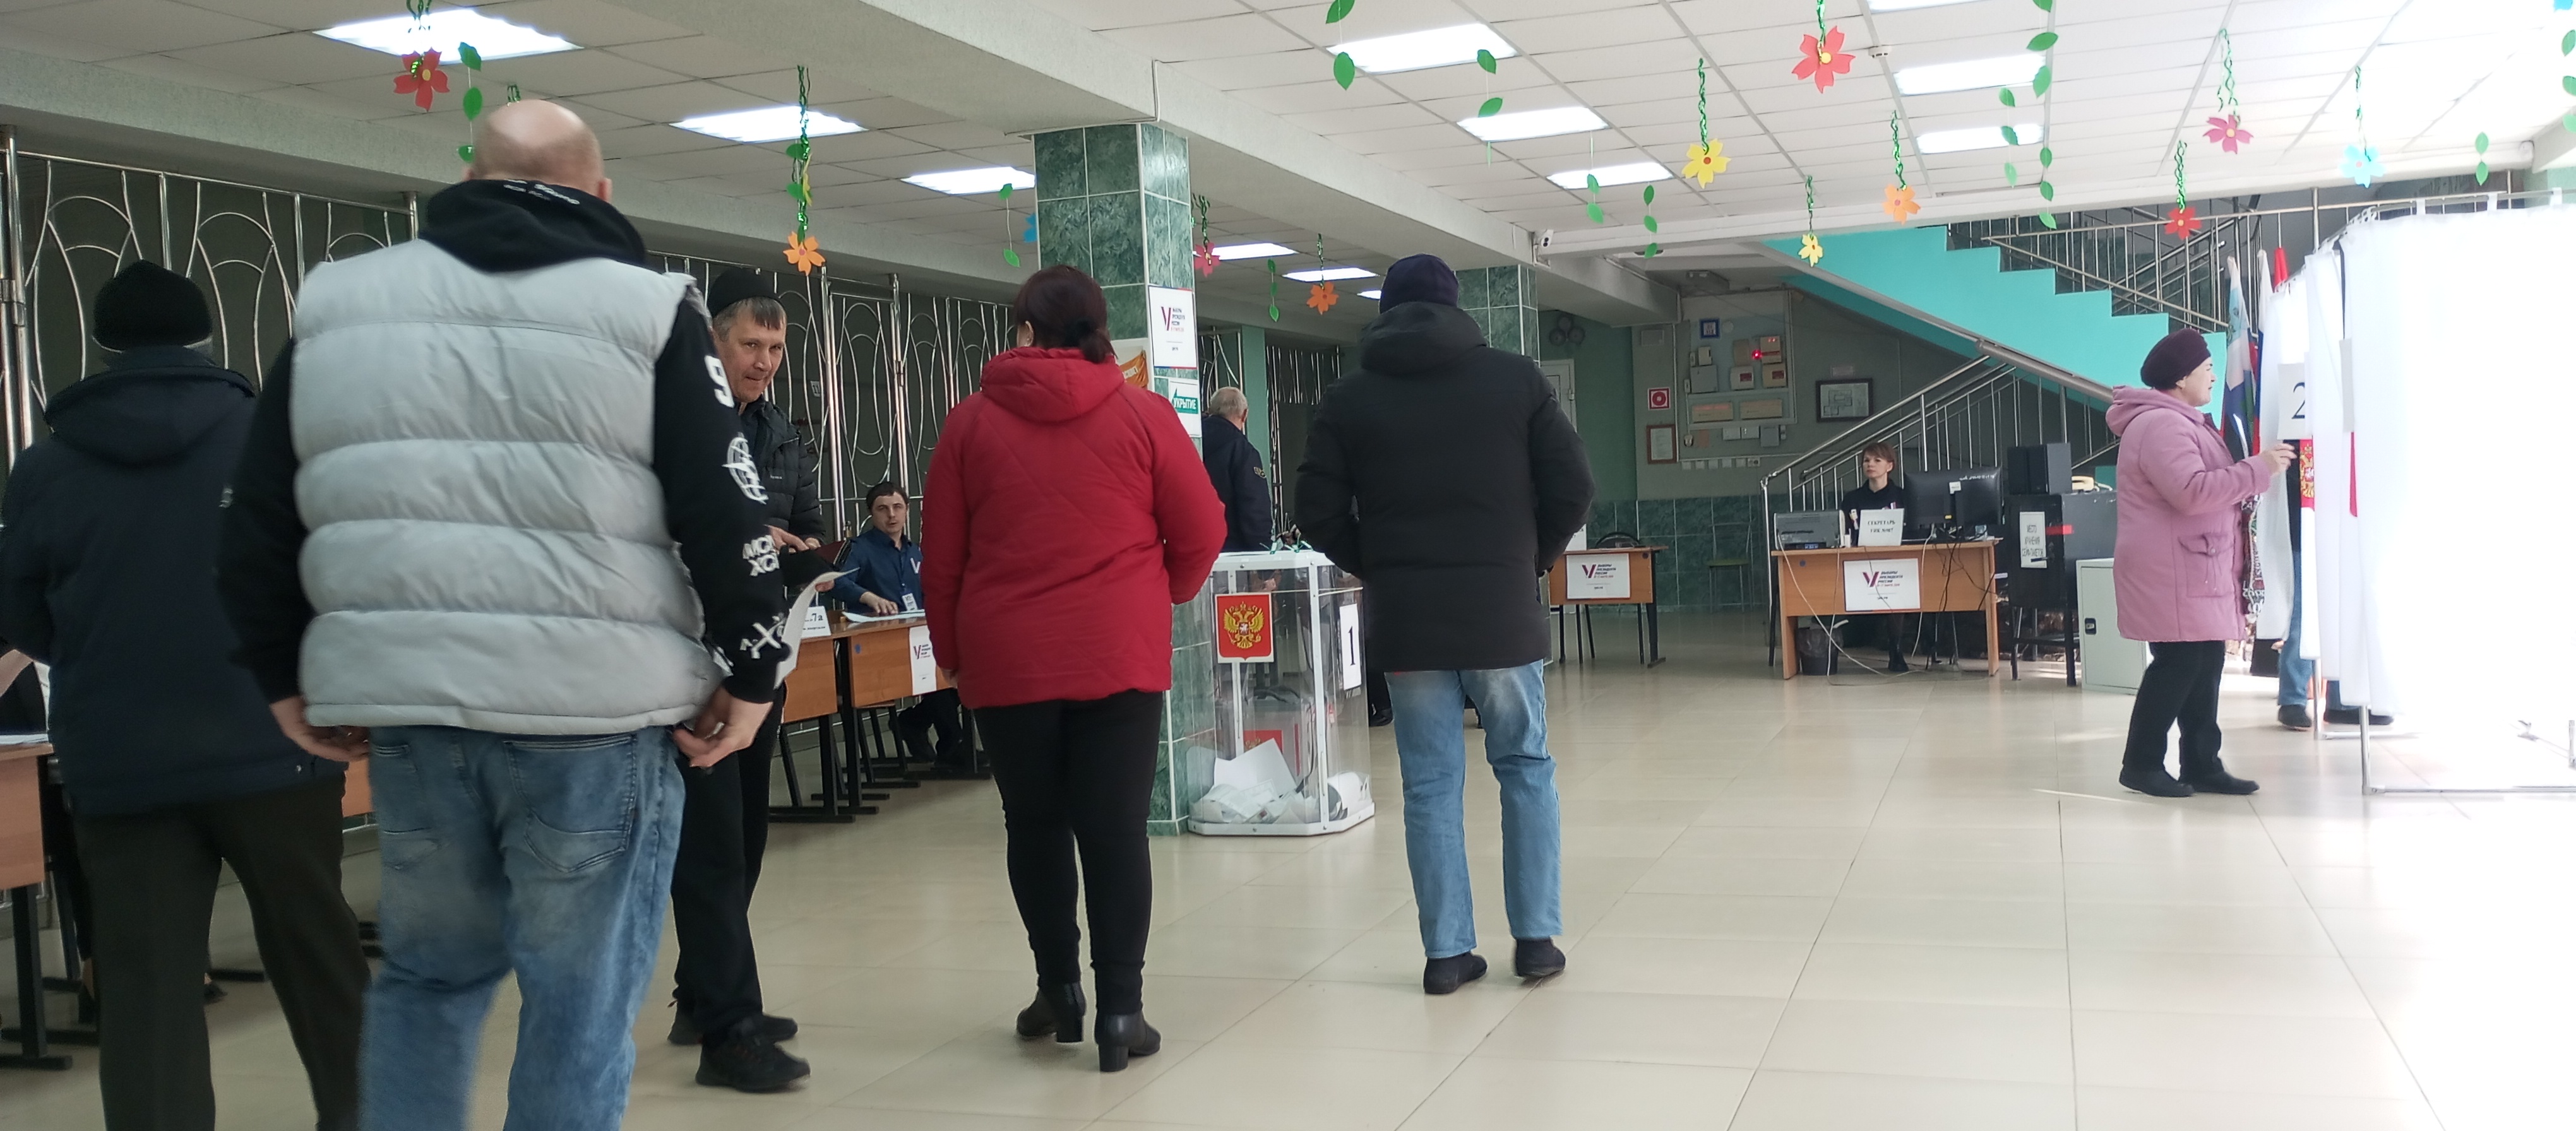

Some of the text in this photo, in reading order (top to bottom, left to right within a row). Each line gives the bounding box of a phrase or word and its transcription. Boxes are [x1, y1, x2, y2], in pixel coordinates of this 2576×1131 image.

[704, 355, 735, 409] 9
[2291, 381, 2306, 420] 2
[1173, 398, 1197, 410] УКРЫТИЕ
[1348, 625, 1356, 666] 1
